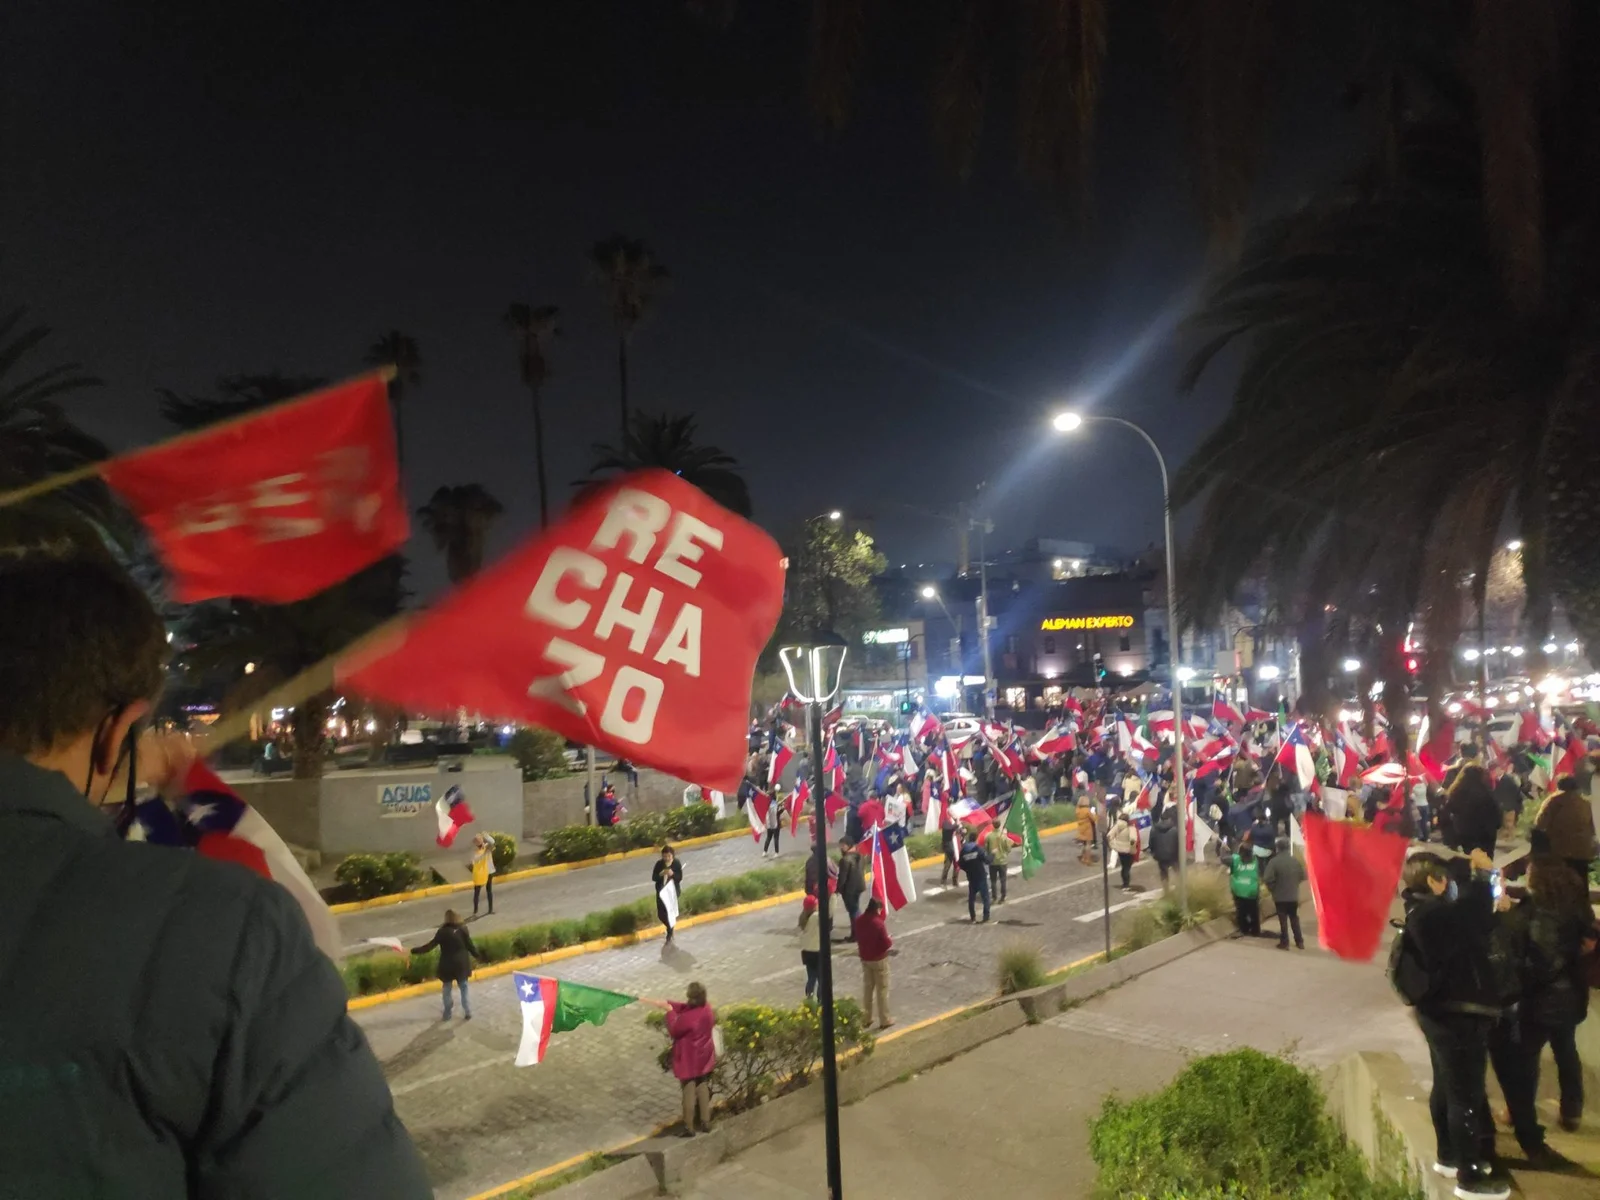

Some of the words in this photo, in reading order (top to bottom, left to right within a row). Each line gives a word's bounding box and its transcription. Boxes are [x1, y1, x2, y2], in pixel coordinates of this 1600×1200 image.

[590, 488, 724, 588] RE
[526, 546, 702, 677] CHA
[1086, 616, 1133, 628] EXPERTO
[528, 637, 664, 744] ZO
[382, 784, 431, 803] AGUAS
